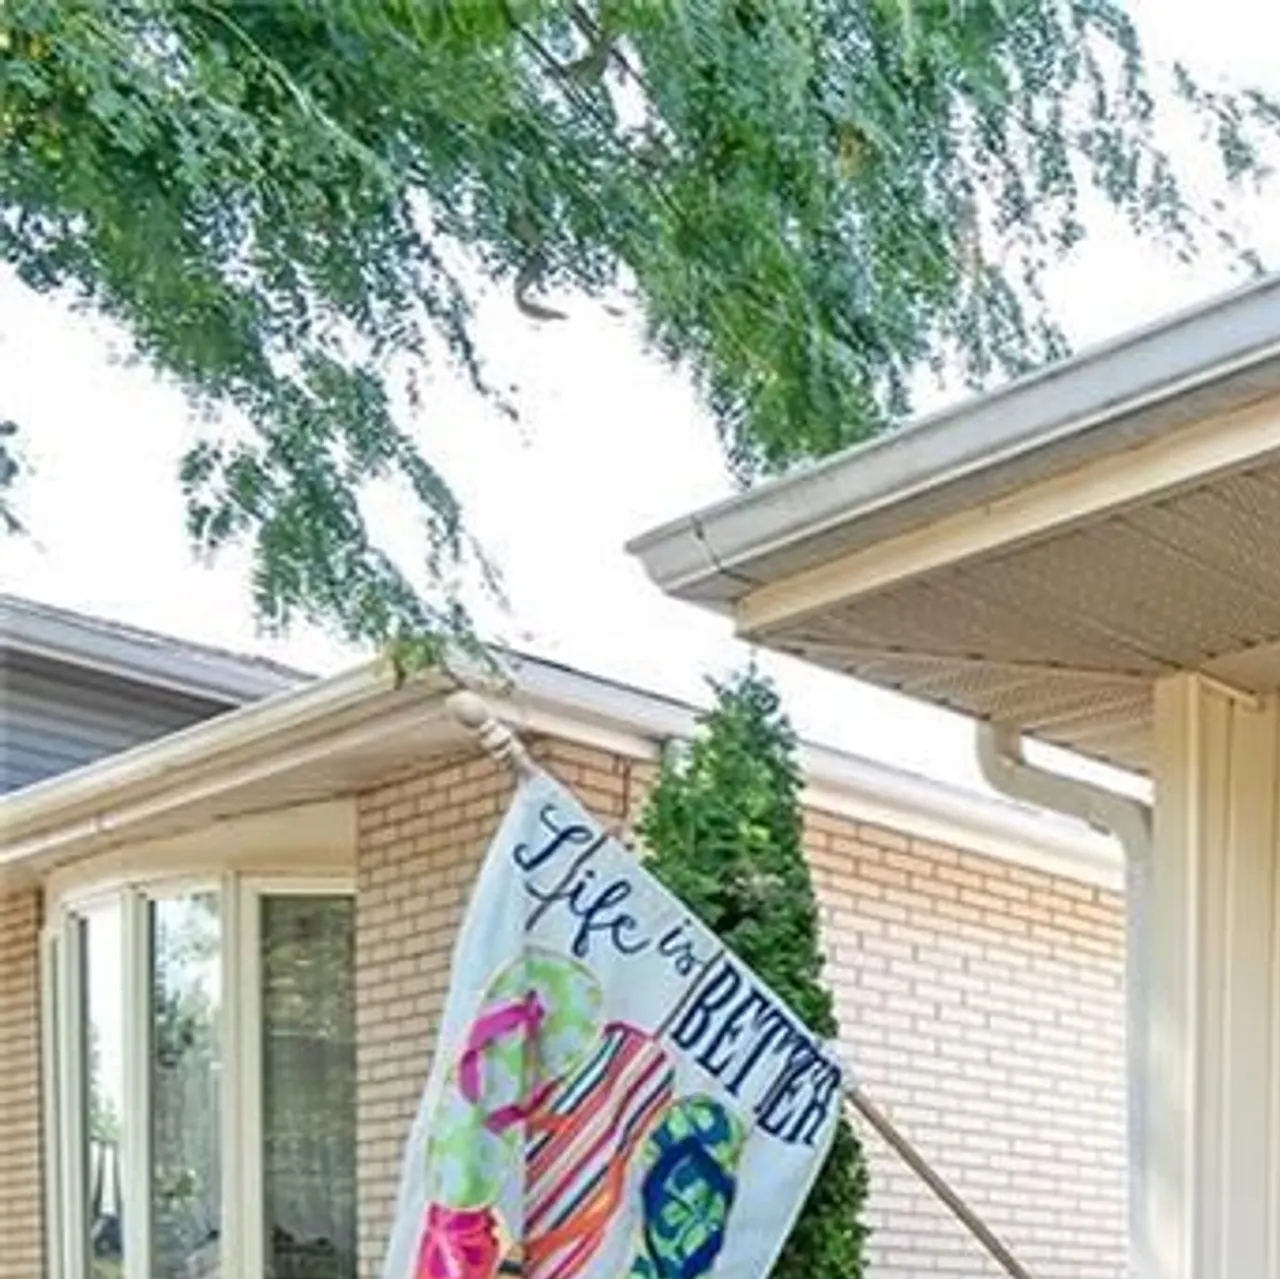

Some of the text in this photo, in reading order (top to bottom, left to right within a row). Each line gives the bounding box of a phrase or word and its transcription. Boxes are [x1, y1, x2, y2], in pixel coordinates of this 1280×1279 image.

[513, 803, 842, 1146] Life is BETTER
